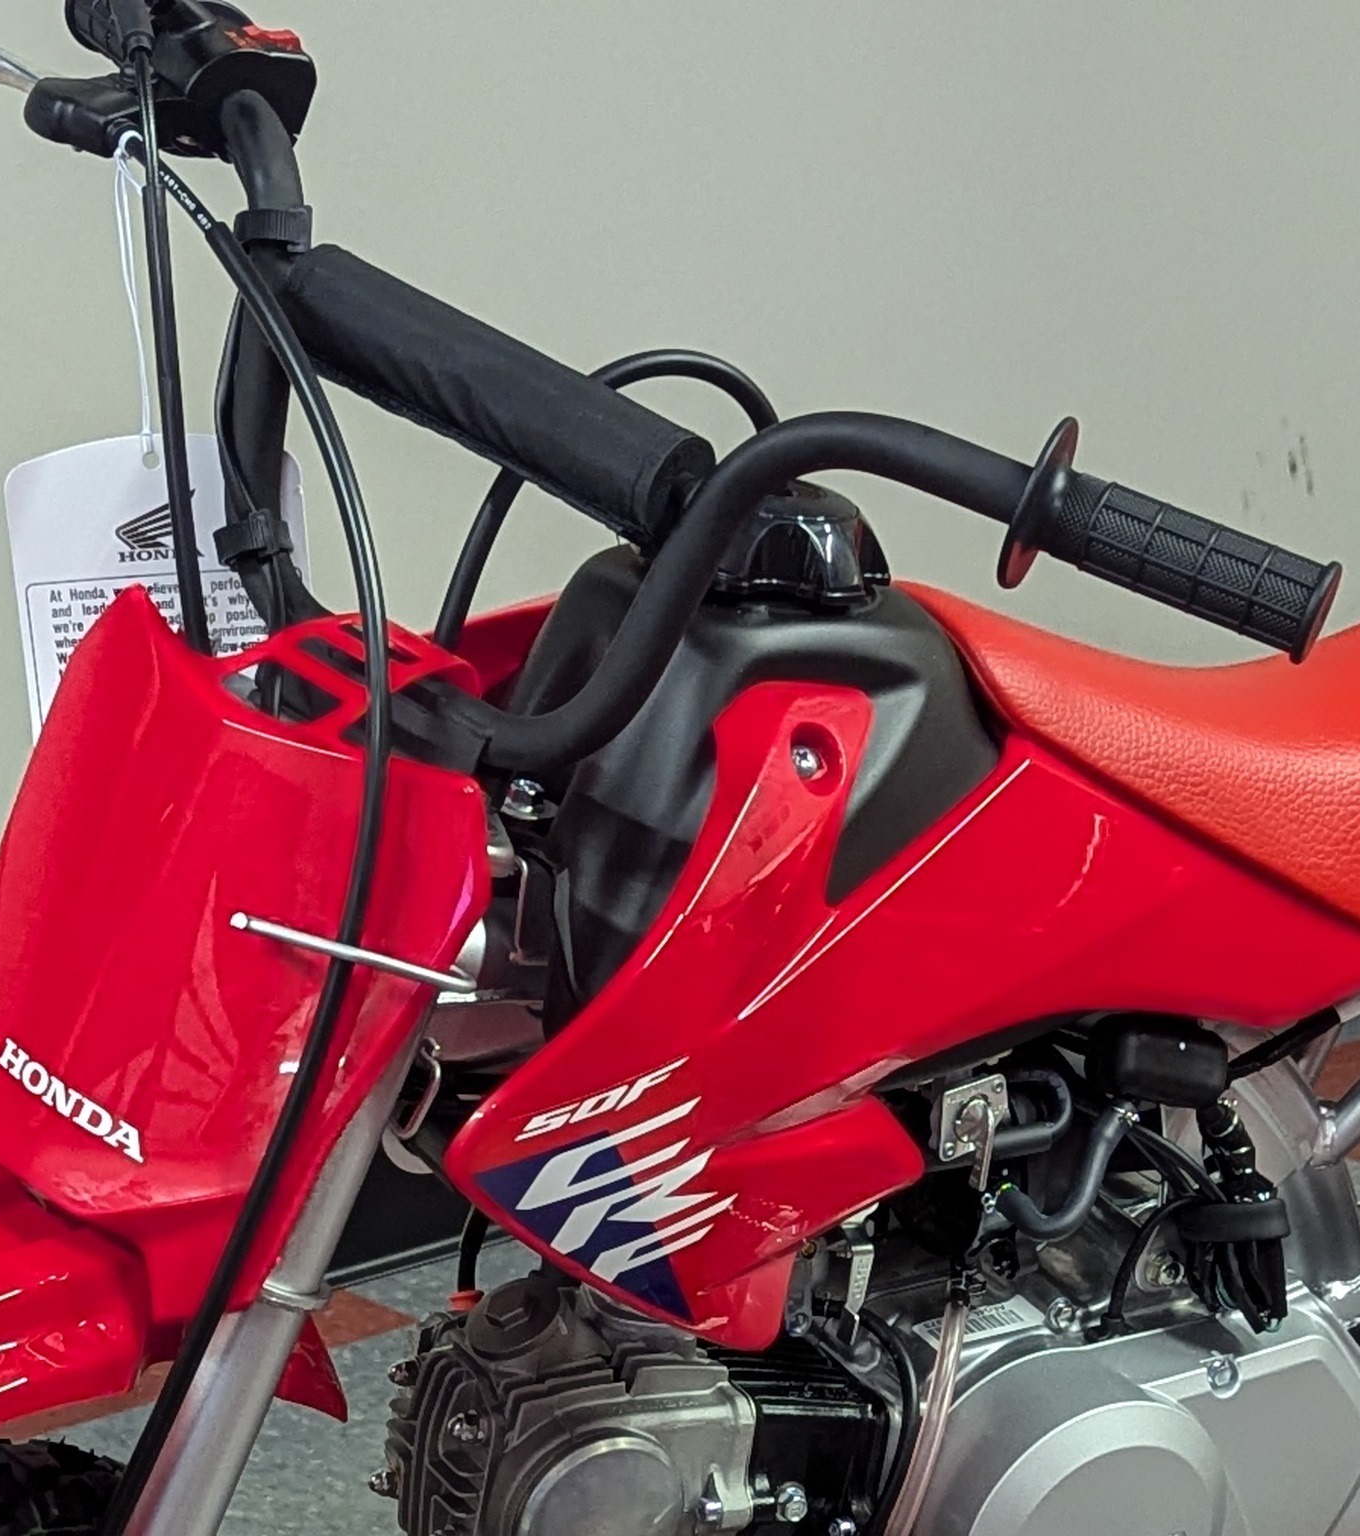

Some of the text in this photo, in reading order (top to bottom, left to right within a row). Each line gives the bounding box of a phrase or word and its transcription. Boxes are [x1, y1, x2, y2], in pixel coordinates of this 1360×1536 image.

[118, 548, 204, 563] HON
[50, 590, 62, 602] At
[69, 587, 108, 601] Honda,
[211, 578, 242, 593] perfo
[51, 605, 72, 618] and
[53, 621, 84, 633] we're
[514, 1056, 690, 1142] 50F
